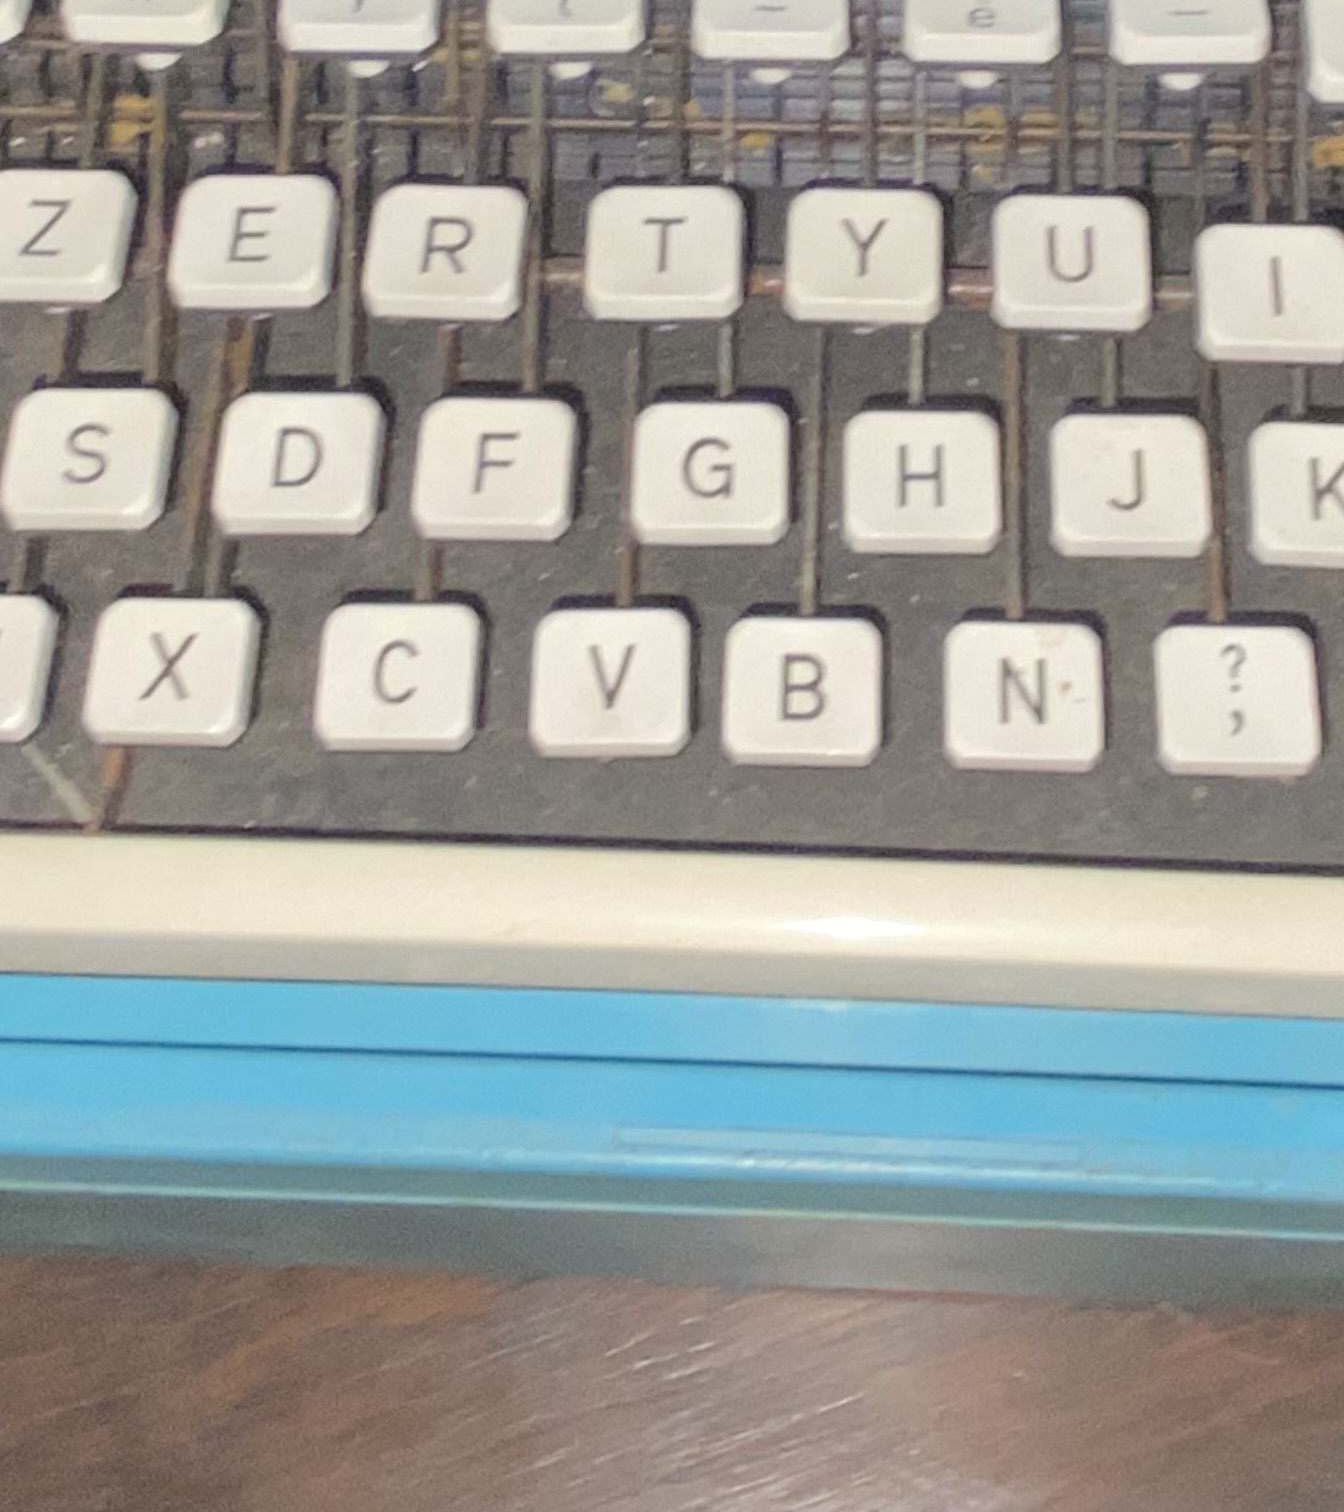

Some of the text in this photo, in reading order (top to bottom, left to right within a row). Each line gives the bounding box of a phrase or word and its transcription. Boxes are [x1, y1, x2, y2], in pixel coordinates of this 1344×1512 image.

[18, 199, 71, 258] Z
[227, 205, 277, 263] E
[420, 216, 474, 274] R
[643, 216, 686, 274] T
[842, 219, 887, 277] Y
[1045, 225, 1095, 284] U
[1269, 255, 1285, 317] I
[62, 422, 110, 485] S
[271, 426, 324, 489] D
[472, 431, 520, 494] F
[681, 436, 734, 499] G
[897, 444, 945, 508] H
[1108, 449, 1146, 512] J
[140, 633, 197, 700] X
[373, 639, 419, 705] C
[588, 644, 636, 710] V
[780, 652, 826, 722] B
[999, 657, 1047, 725] N
[1219, 642, 1248, 693] ?
